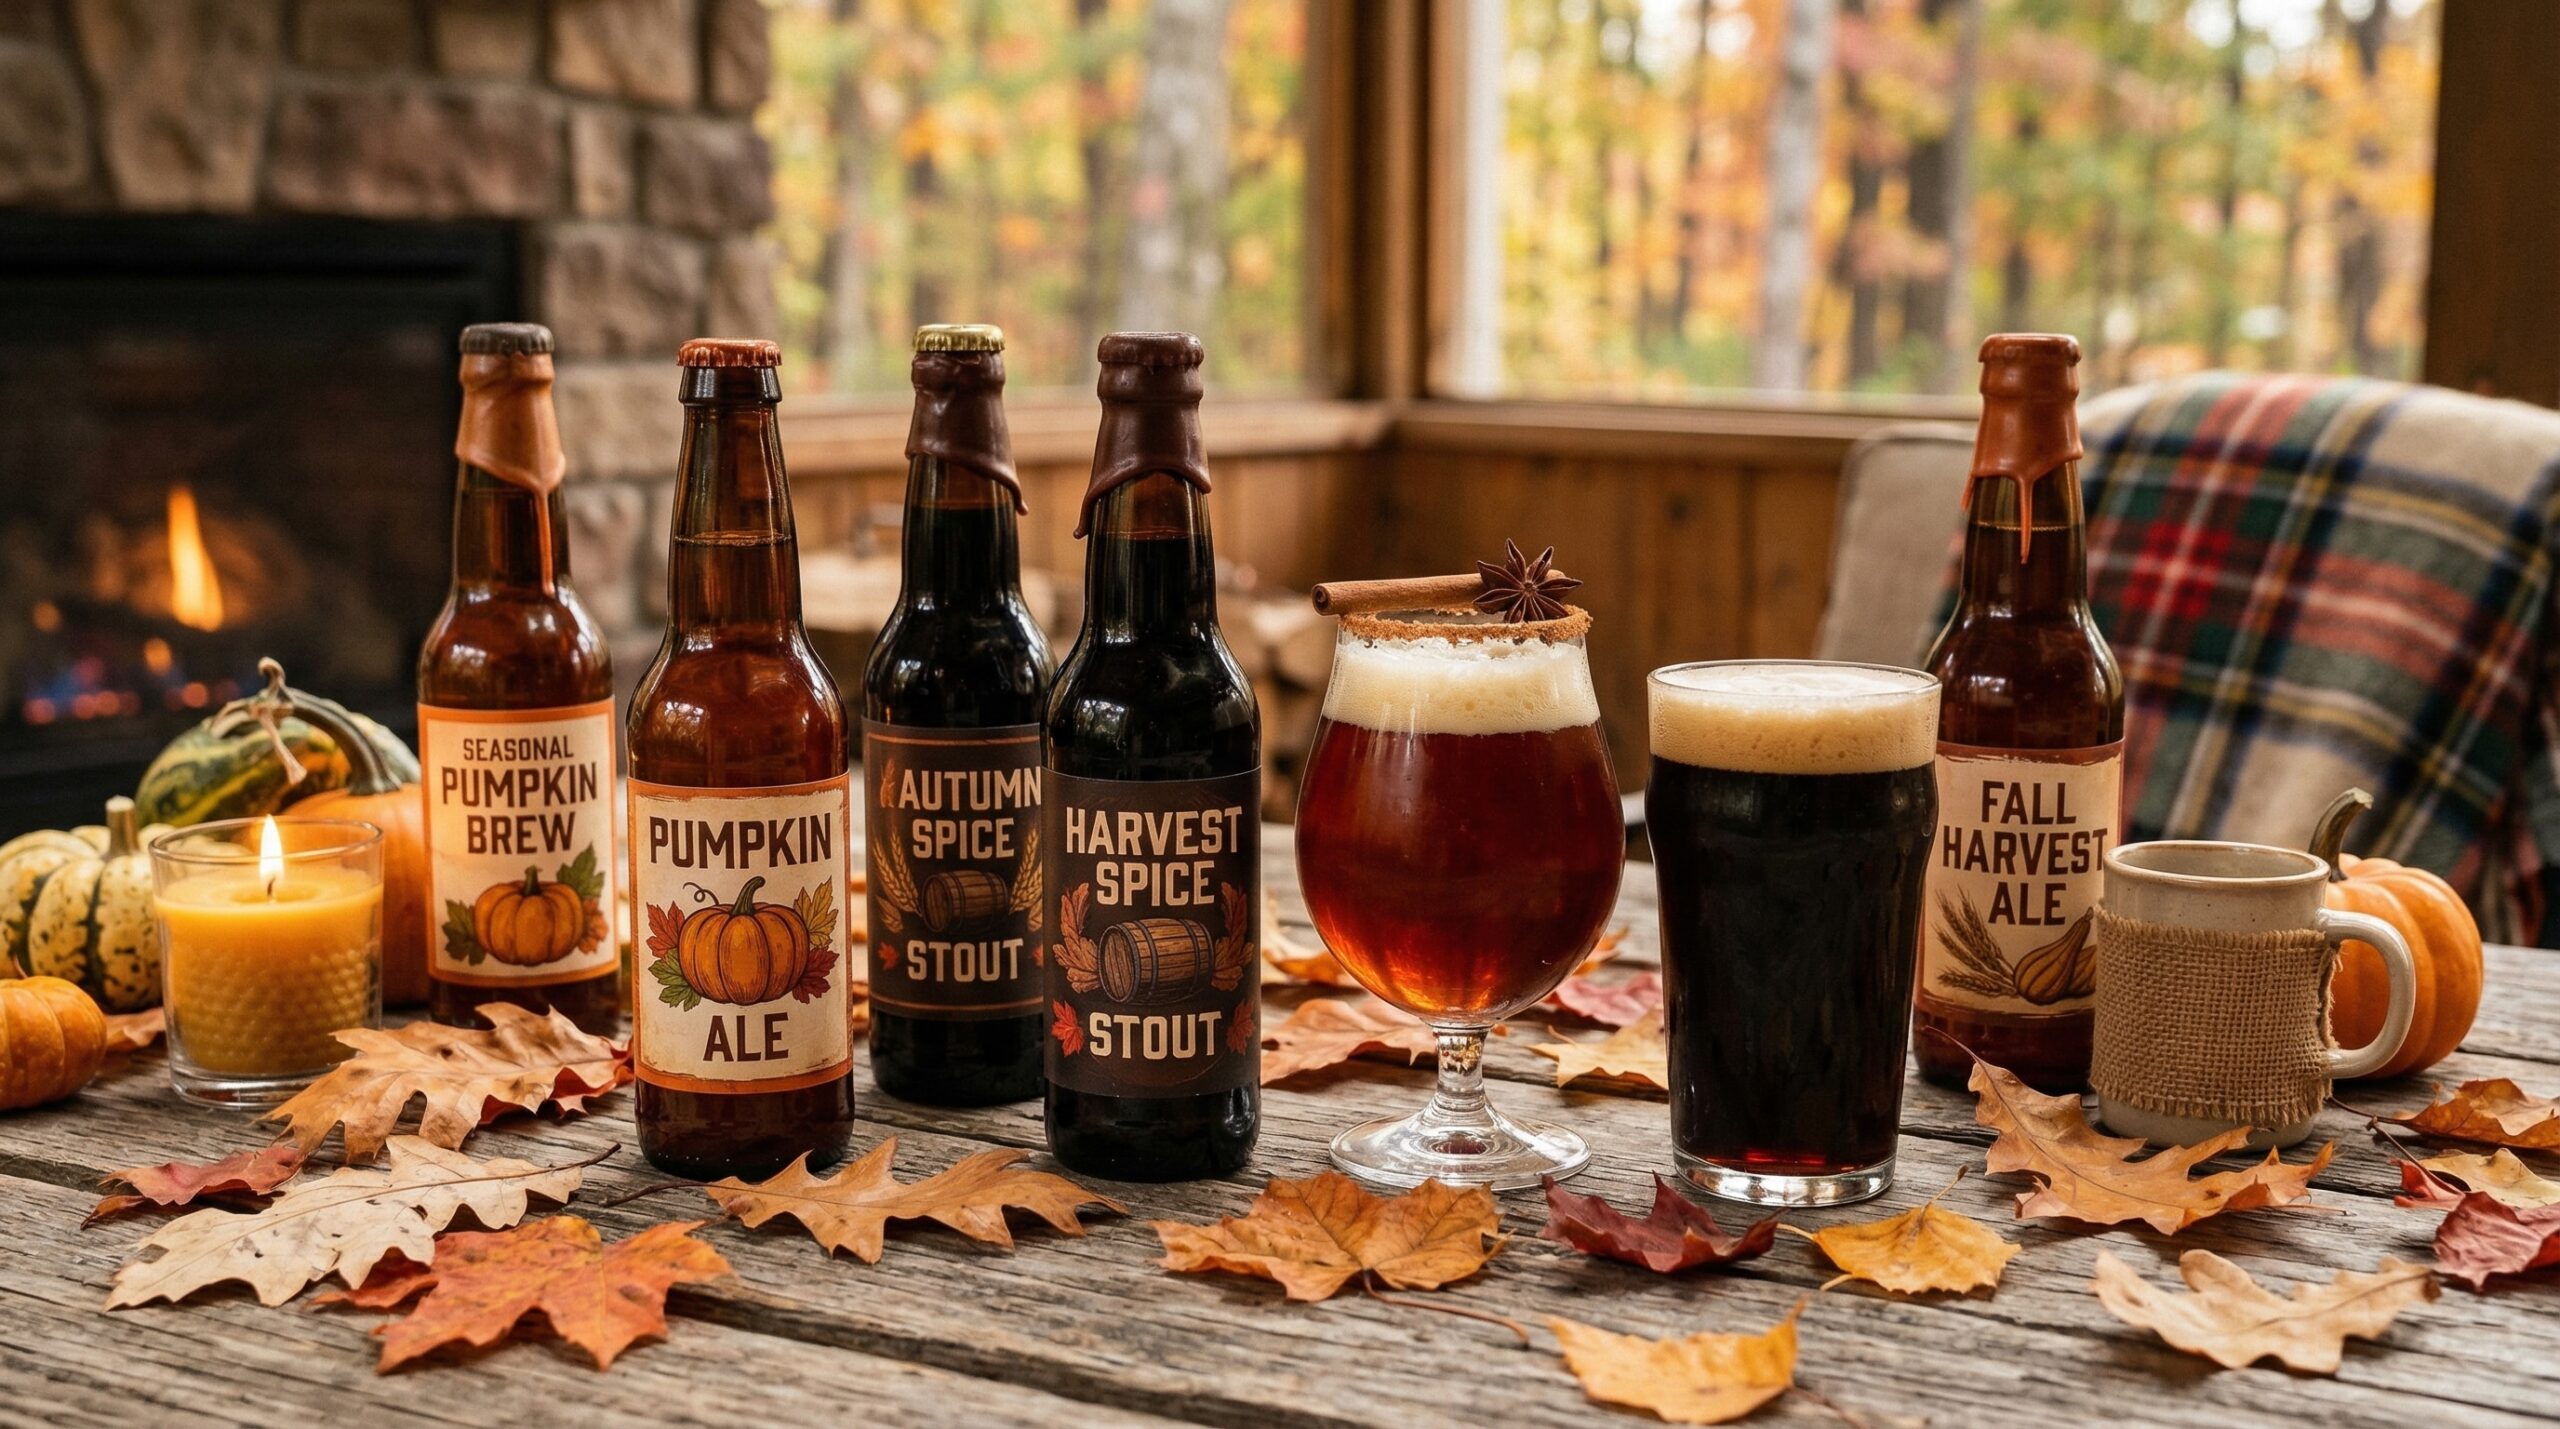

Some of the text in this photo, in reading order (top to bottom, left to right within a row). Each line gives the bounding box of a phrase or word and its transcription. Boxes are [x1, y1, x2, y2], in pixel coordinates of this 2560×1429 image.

[463, 735, 574, 762] SEASONAL
[441, 762, 597, 808] PUMPKIN
[898, 766, 1041, 812] AUTUMN
[1981, 780, 2077, 825] FALL
[467, 811, 576, 855] BREW
[649, 812, 831, 870] PUMPKIN
[912, 817, 1015, 860] SPICE
[1066, 806, 1242, 856] HARVEST
[1943, 825, 2108, 876] HARVEST
[1096, 860, 1215, 907] SPICE
[1988, 881, 2067, 926] ALE
[907, 938, 1023, 983] STOUT
[703, 1012, 789, 1062] ALE
[1089, 1011, 1222, 1060] STOUT
